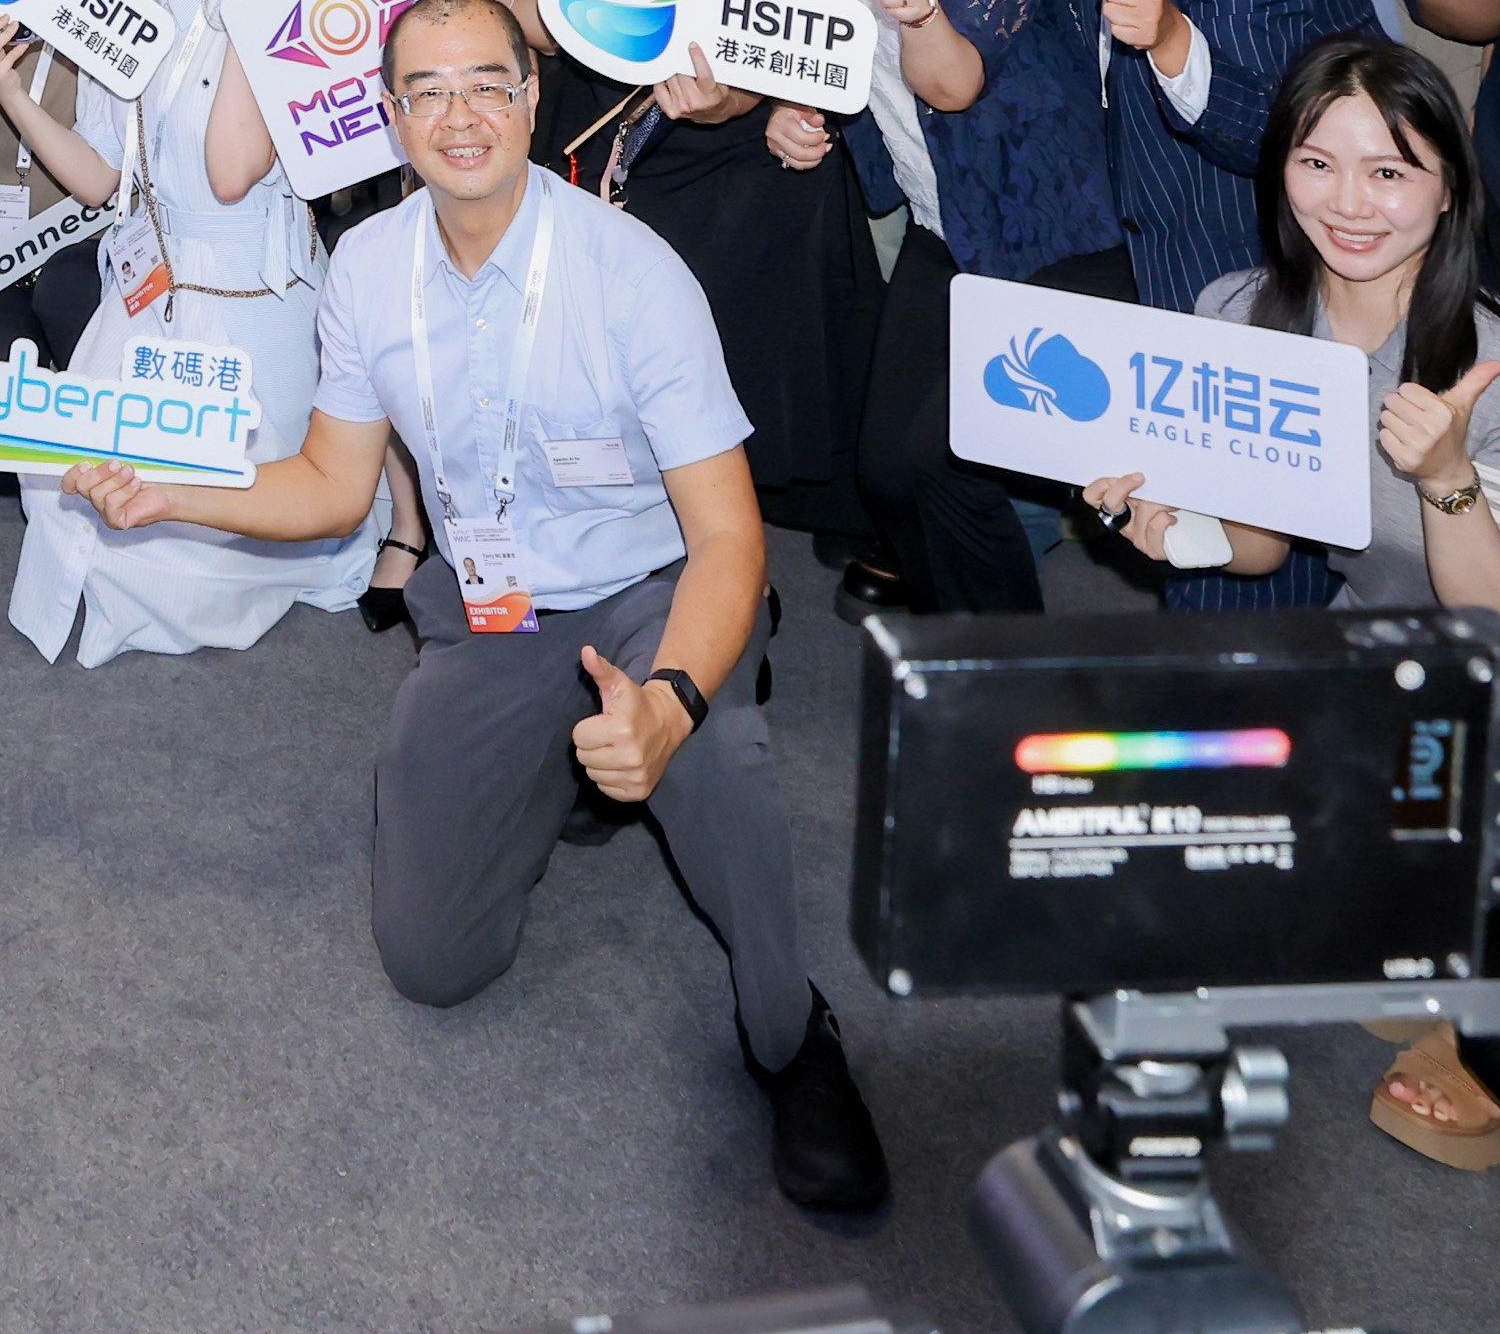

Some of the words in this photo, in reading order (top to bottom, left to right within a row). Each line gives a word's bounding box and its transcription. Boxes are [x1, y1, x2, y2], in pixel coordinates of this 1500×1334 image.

[51, 4, 141, 81] 港深創科園
[714, 35, 850, 92] 港深創科園
[132, 345, 243, 393] 數碼港
[1128, 351, 1321, 447] 亿格云
[1129, 416, 1214, 450] EAGLE
[1229, 438, 1323, 473] CLOUD
[469, 606, 509, 616] EXHIBITOR
